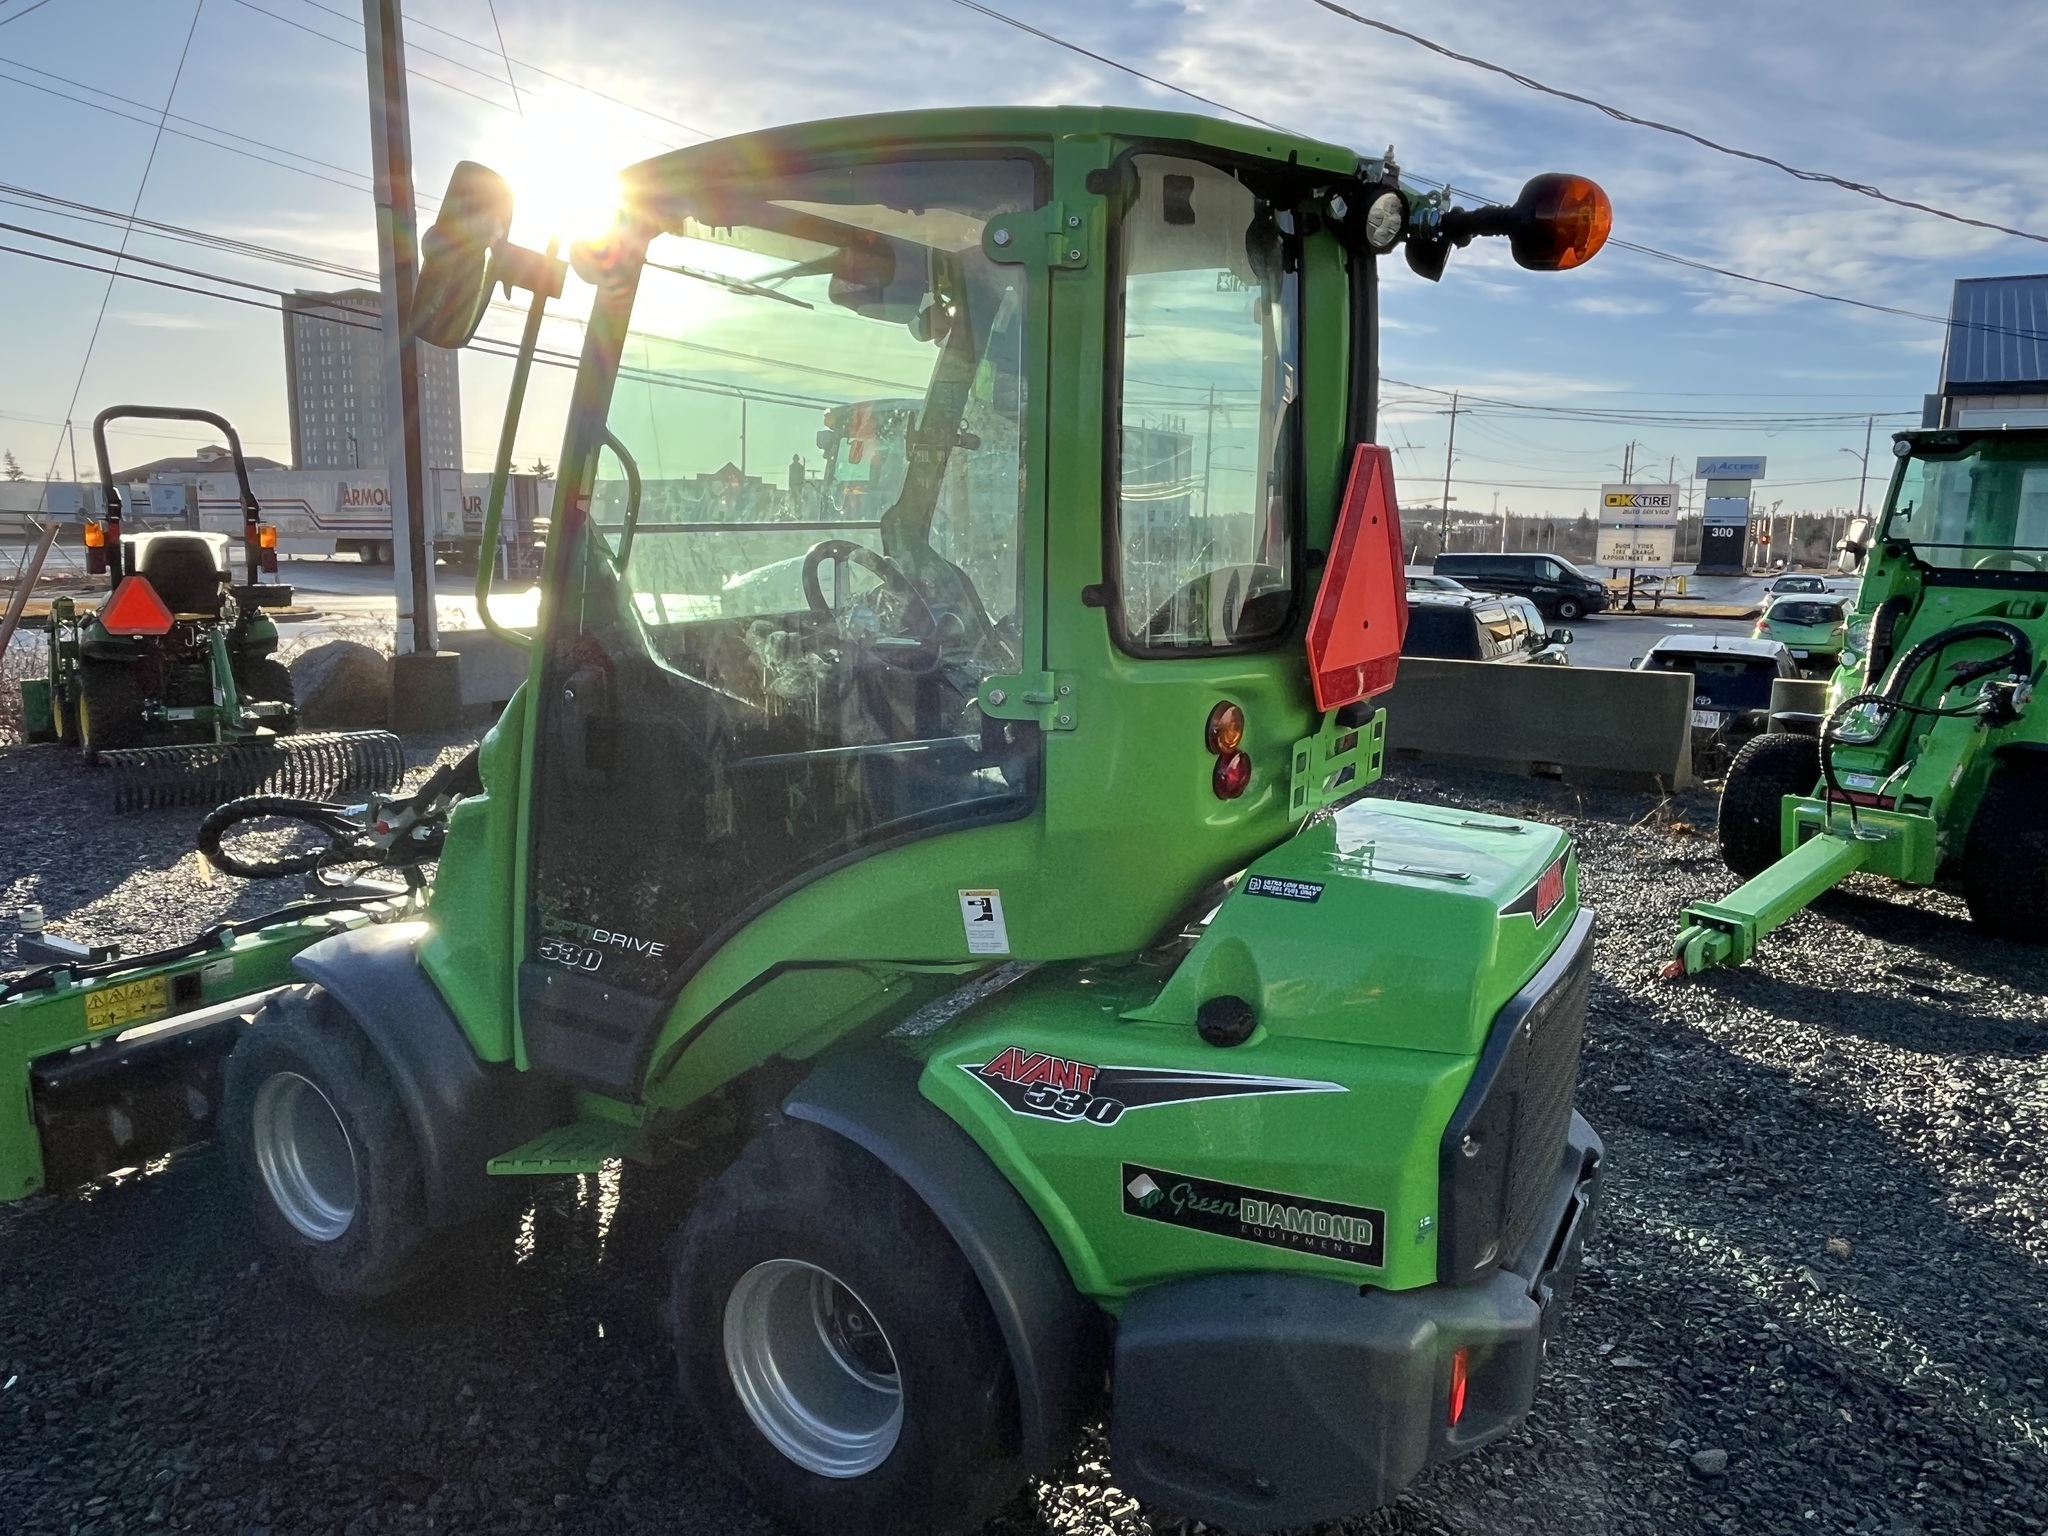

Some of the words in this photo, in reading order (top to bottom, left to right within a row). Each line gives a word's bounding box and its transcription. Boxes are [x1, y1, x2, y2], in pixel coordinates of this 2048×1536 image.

[343, 488, 391, 506] ARMOU
[1605, 494, 1636, 507] OK
[1641, 496, 1669, 506] TIRE
[1711, 527, 1734, 538] 300
[538, 936, 603, 971] 530
[979, 1046, 1099, 1094] AVANT
[1023, 1081, 1126, 1126] 530
[1169, 1182, 1240, 1217] Green
[1239, 1197, 1373, 1246] DIAMOND
[1241, 1225, 1356, 1254] EQUIPMENT
